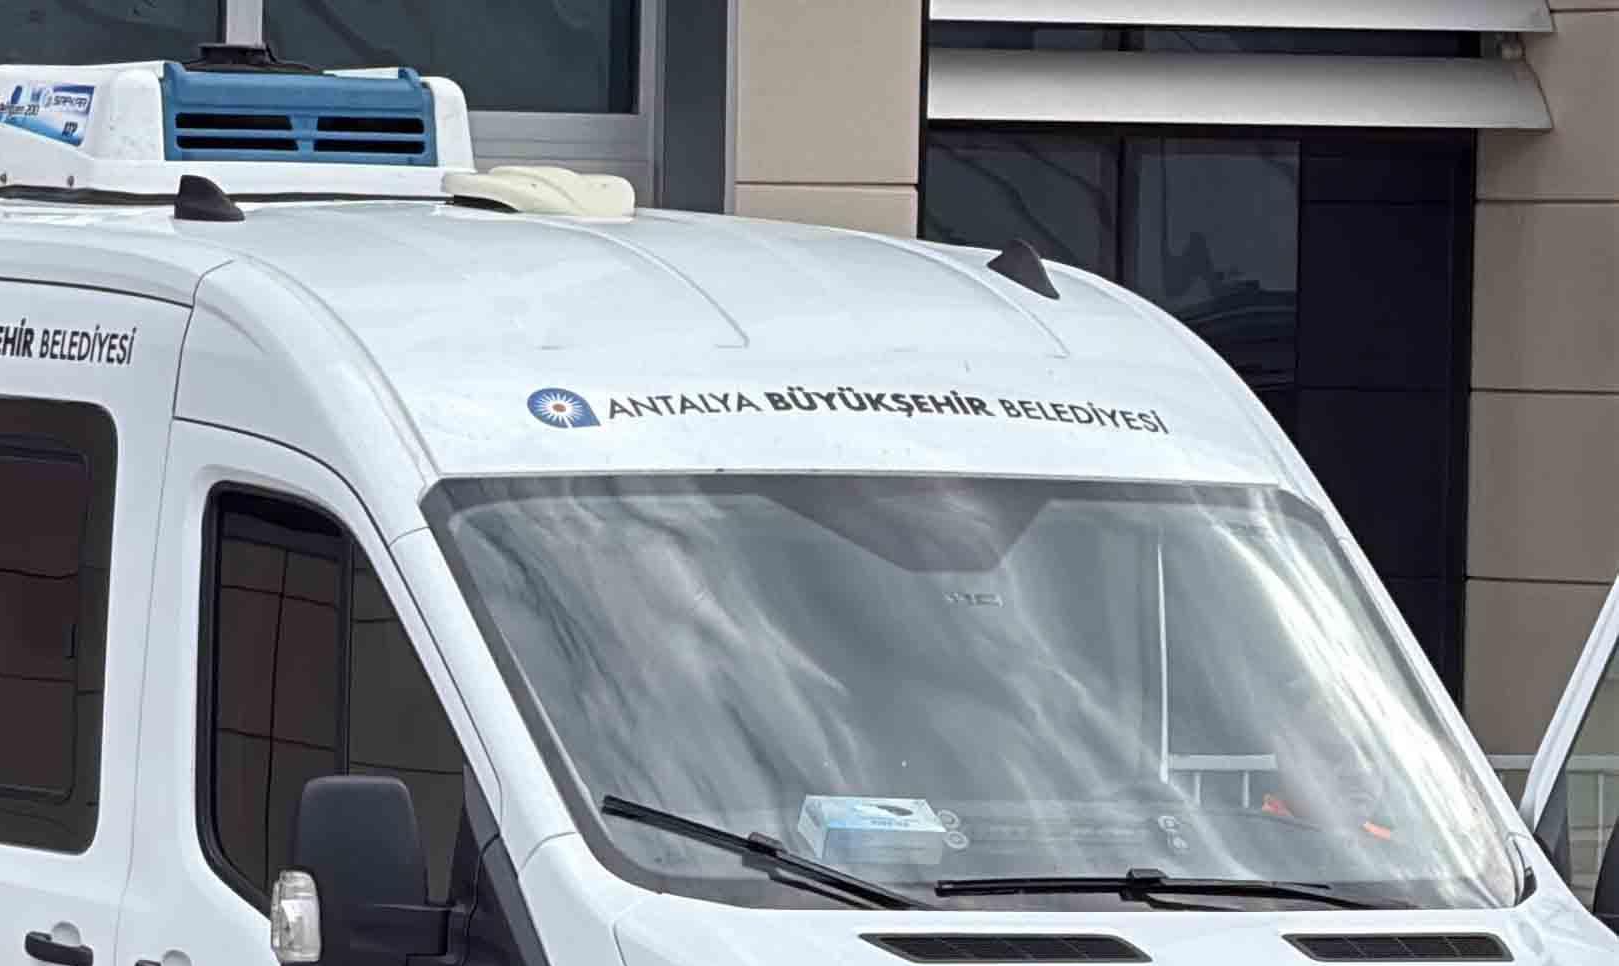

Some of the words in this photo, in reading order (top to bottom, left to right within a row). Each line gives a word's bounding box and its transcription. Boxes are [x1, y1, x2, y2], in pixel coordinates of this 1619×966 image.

[39, 324, 137, 365] BELEDİYESİ
[609, 391, 763, 420] ANTALYA
[763, 386, 995, 418] BÜYÜKŞEHİR
[998, 398, 1170, 435] BELEDİYESİ
